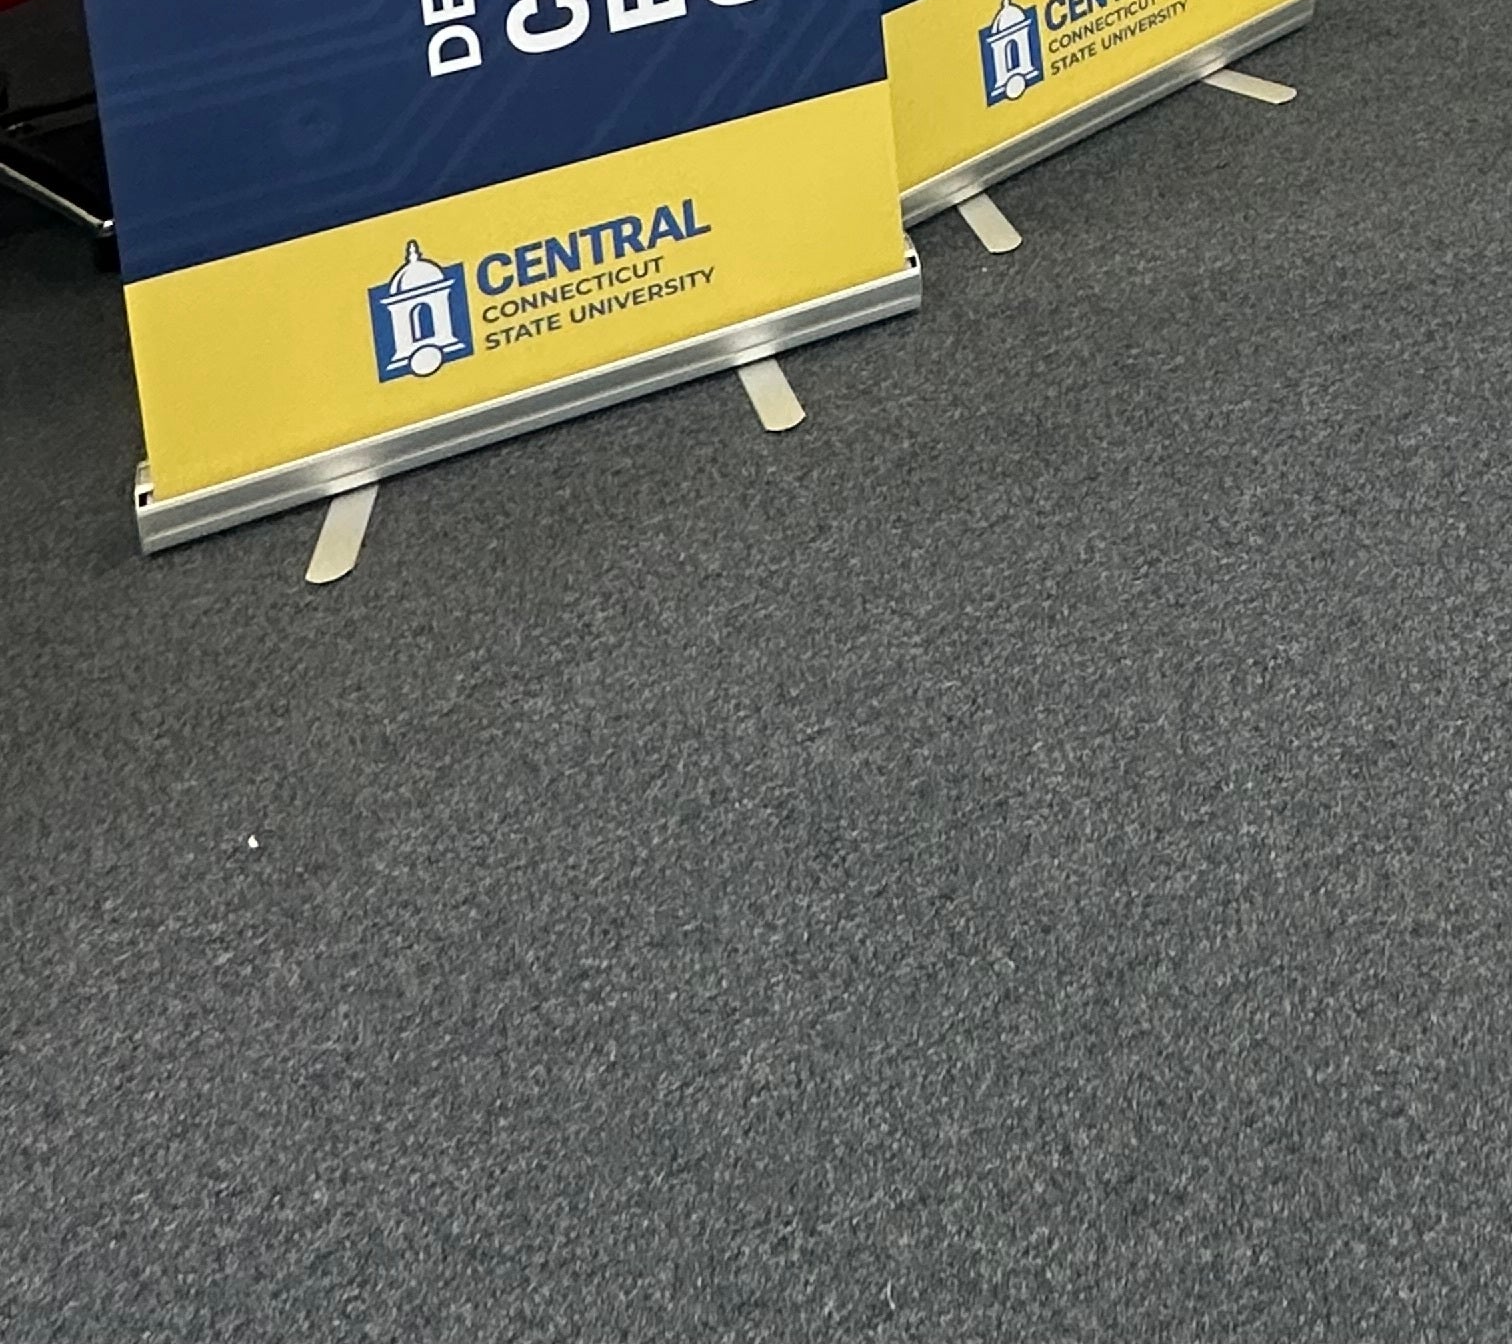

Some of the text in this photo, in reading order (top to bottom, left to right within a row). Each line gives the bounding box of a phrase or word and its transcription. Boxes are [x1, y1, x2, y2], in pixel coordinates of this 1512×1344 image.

[1050, 43, 1098, 76] STATE
[475, 199, 712, 296] CENTRAL
[482, 256, 664, 323] CONNECTICUT
[485, 265, 715, 350] STATE UNIVERSITY
